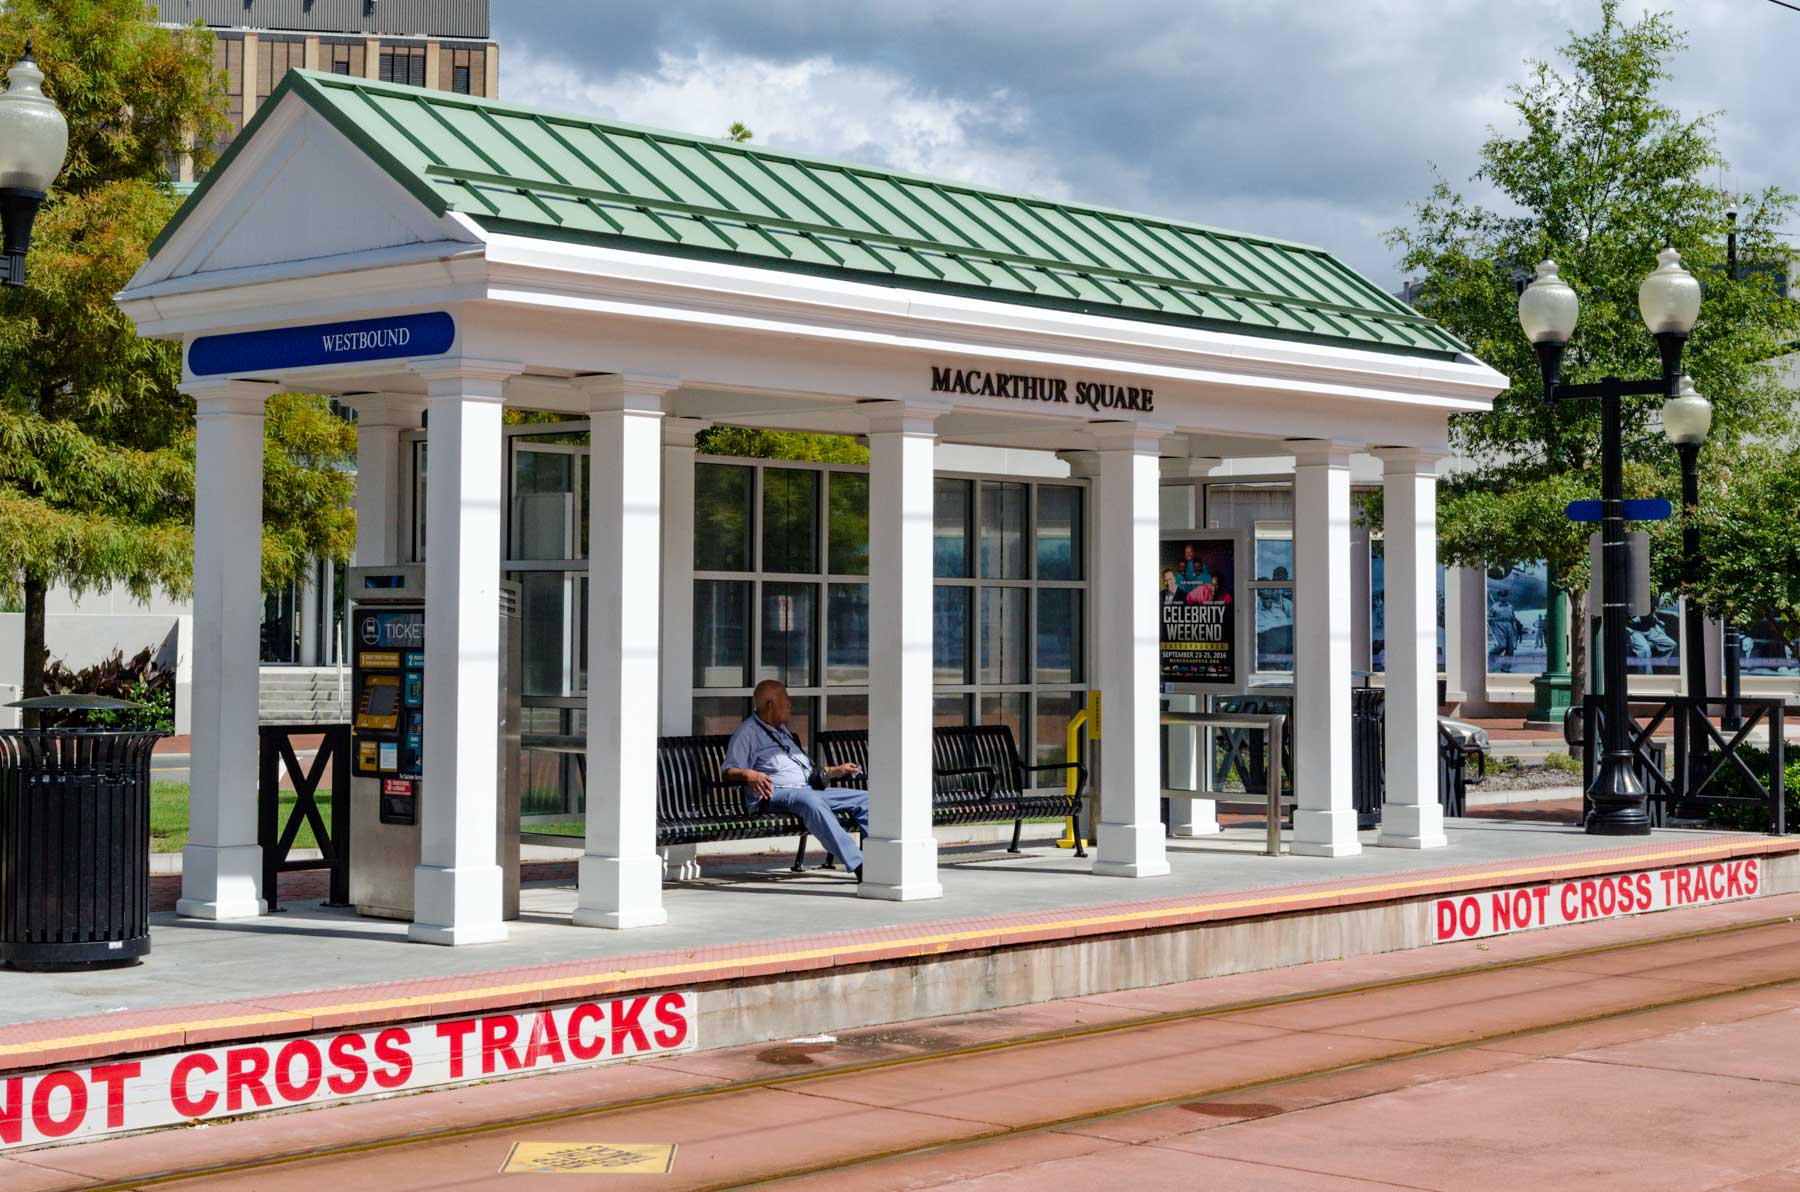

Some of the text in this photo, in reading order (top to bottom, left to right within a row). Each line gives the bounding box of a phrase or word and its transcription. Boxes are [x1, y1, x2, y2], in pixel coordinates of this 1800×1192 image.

[322, 327, 410, 352] WESTBOUND
[931, 367, 1154, 412] MACARTHUR SQUARE
[1163, 605, 1226, 624] CELEBRITY
[1166, 624, 1222, 641] WEEKEND
[1437, 859, 1759, 940] DO NOT CROSS TRACKS
[170, 1027, 413, 1118] CROSS
[436, 992, 688, 1078] TRACKS
